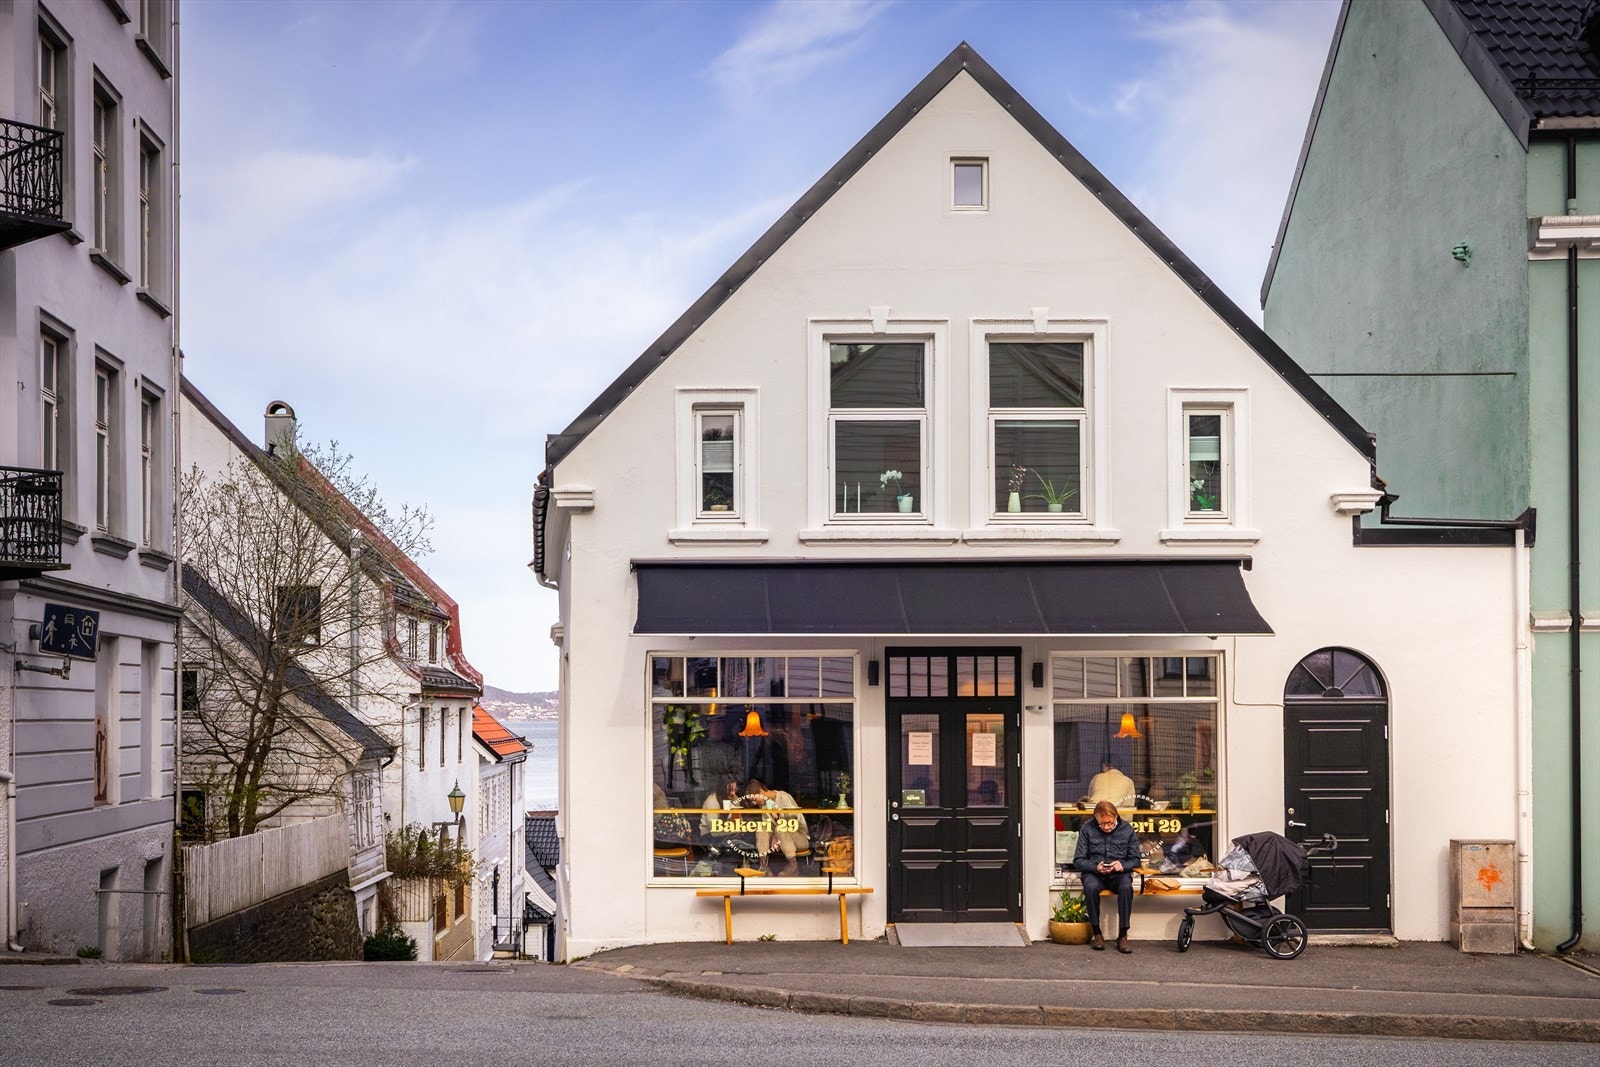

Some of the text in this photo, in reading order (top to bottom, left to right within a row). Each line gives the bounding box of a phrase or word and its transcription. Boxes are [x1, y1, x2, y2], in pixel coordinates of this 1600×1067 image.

[710, 818, 799, 833] Bakeri 29
[1129, 818, 1182, 833] eri 29
